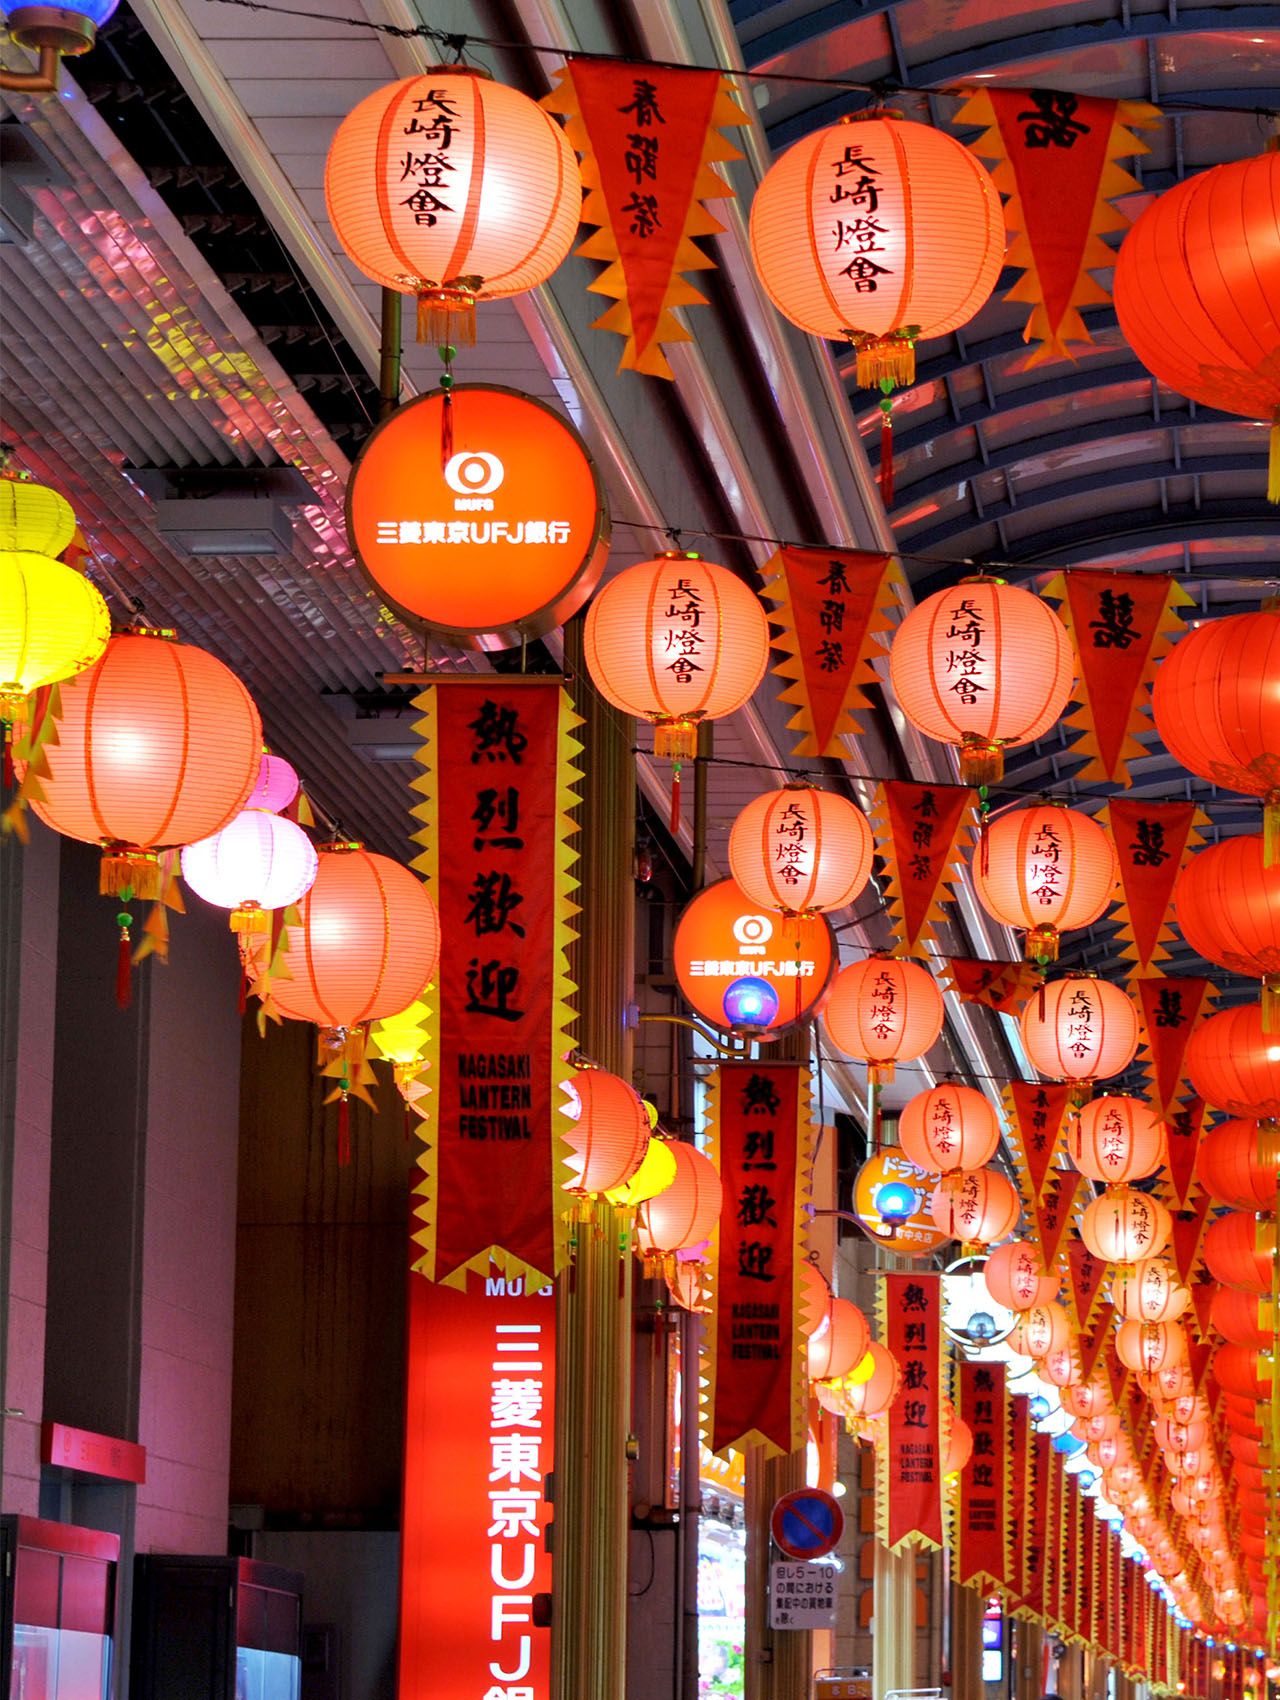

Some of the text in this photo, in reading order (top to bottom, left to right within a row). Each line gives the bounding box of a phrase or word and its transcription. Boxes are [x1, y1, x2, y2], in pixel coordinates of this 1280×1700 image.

[401, 88, 456, 227] 長崎燈會
[830, 145, 892, 293] 長崎燈會
[376, 521, 571, 544] 三菱東京UFJ銀行
[664, 579, 705, 684] 長崎燈會
[945, 599, 988, 705] 長崎燈會
[465, 699, 528, 1022] 熱烈歡迎
[775, 804, 808, 885] 長崎燈會
[1032, 824, 1063, 905] 長崎燈會
[871, 971, 897, 1040] 長崎燈會
[1067, 990, 1094, 1058] 長崎燈會
[458, 1053, 531, 1080] NAGASAKI
[459, 1084, 531, 1110] LANTERN
[458, 1113, 531, 1142] FESTIVAL
[738, 1073, 781, 1283] 熱烈歡迎
[485, 1278, 553, 1297] MUG
[901, 1283, 928, 1429] 熱烈歡迎
[487, 1324, 543, 1700] 三菱東京UFJ
